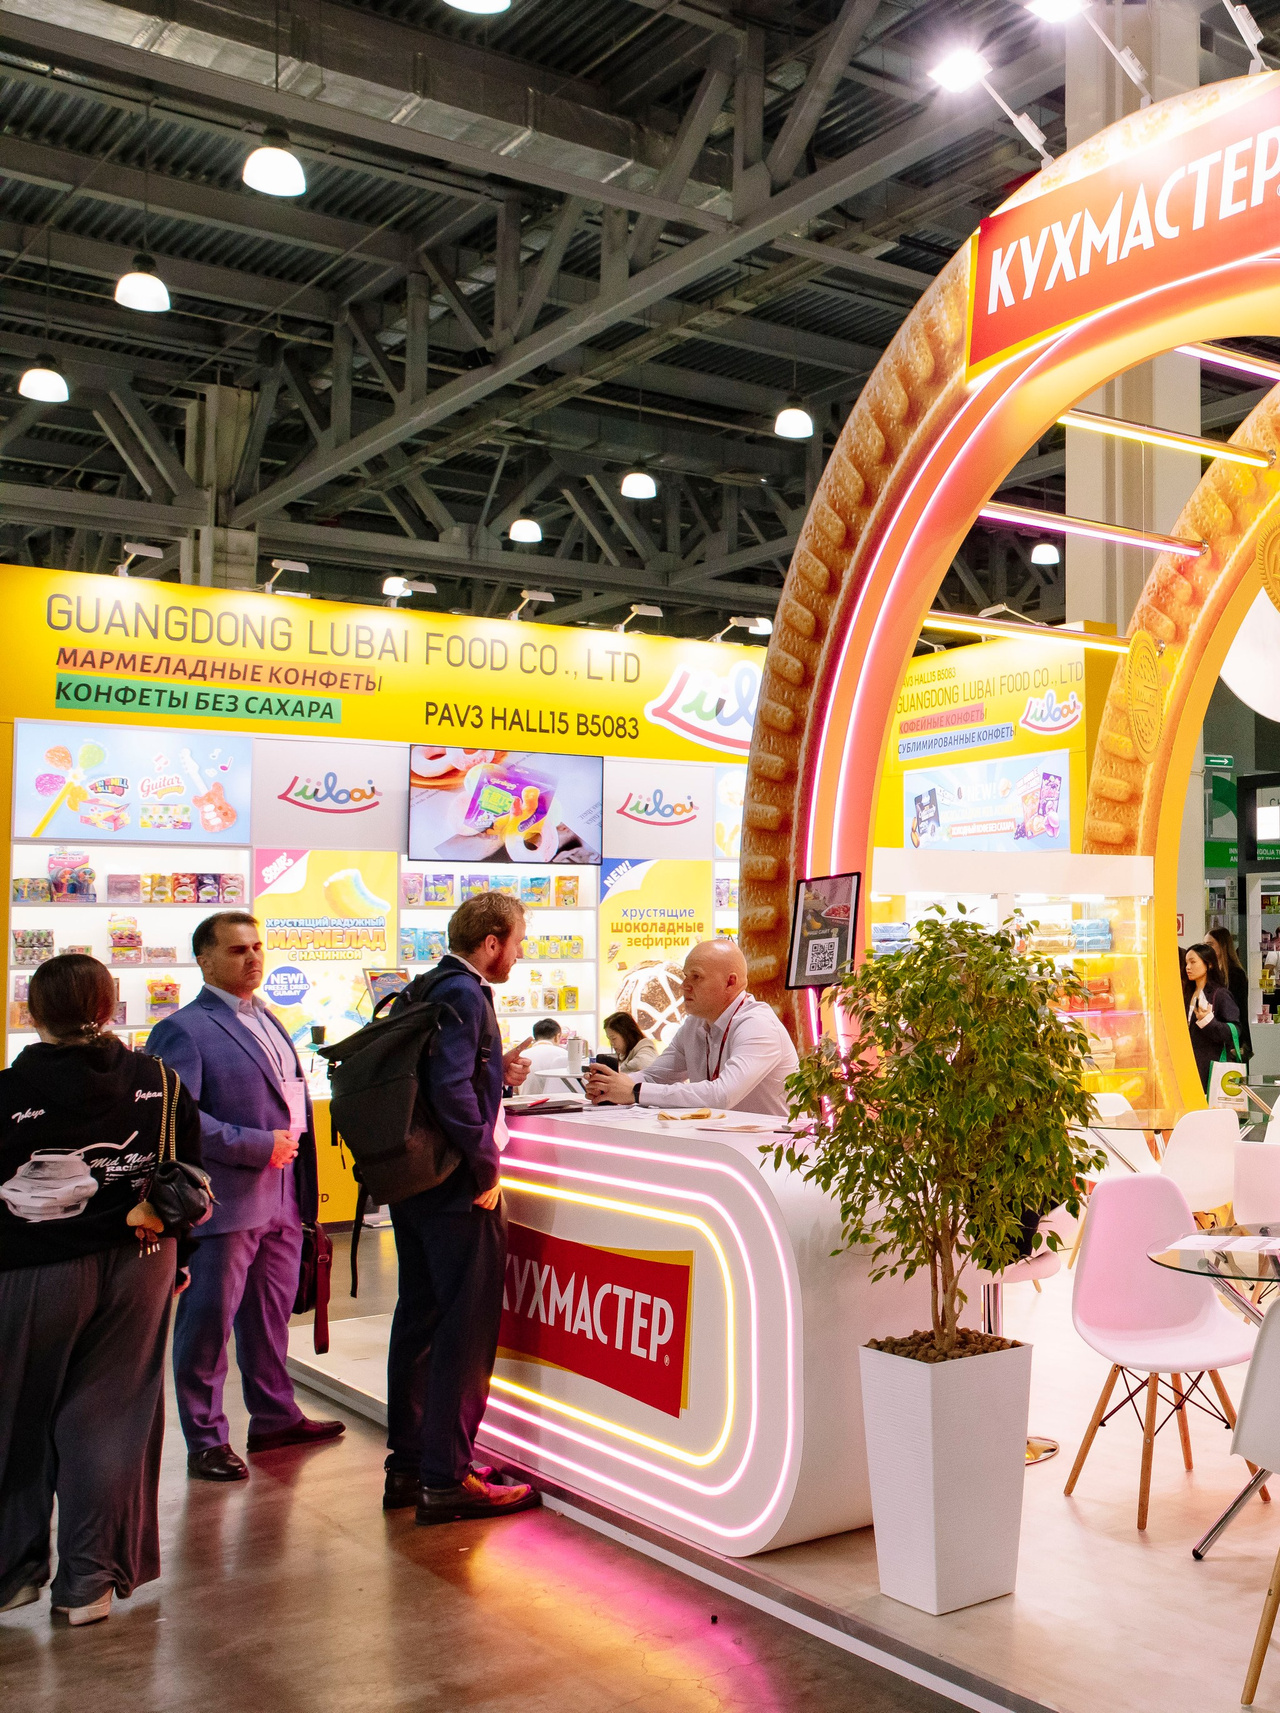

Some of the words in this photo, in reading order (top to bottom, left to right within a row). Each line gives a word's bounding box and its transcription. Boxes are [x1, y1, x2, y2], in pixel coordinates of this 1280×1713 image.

[46, 593, 293, 652] GUANGDONG
[308, 619, 409, 663] LUBAI
[425, 632, 508, 672] FOOD
[586, 648, 641, 684] LTD
[56, 647, 263, 683] МАРМЕЛАДНЫЕ
[267, 665, 383, 692] КОНФЕТЫ
[915, 671, 937, 686] HALL15
[937, 667, 956, 681] B5083
[55, 681, 188, 709] КОНФЕТЫ
[195, 691, 238, 713] БЕЗ
[245, 696, 335, 720] САХАРА
[896, 685, 959, 714] GUANGDONG
[963, 677, 996, 702] LUBAI
[1000, 671, 1030, 695] FOOD
[425, 701, 484, 729] PAV3
[491, 706, 569, 735] HALL15
[576, 714, 640, 740] B5083
[899, 716, 944, 734] КОФЕЙНЫЕ
[945, 708, 988, 727] КОНФЕТЫ
[898, 731, 976, 755] СУБЛИМИРОВАННЫЕ
[977, 725, 1017, 742] КОНФЕТЫ
[140, 776, 182, 797] Guitar
[603, 860, 632, 888] NEW!
[265, 916, 329, 929] ХРУСТЯЩИЙ
[330, 916, 386, 929] РАДУЖНЫЙ
[622, 908, 695, 920] хрустящие
[611, 922, 704, 935] шоколадные
[266, 928, 387, 951] МАРМЕЛАД
[626, 934, 690, 949] зефирки
[298, 949, 363, 961] НАЧИНКОЙ
[263, 983, 288, 993] FREEZE
[289, 983, 310, 992] DRIED
[270, 972, 304, 985] NEW!
[135, 1089, 163, 1103] Japan
[11, 1107, 46, 1123] Tokyo
[90, 1156, 120, 1169] Mid
